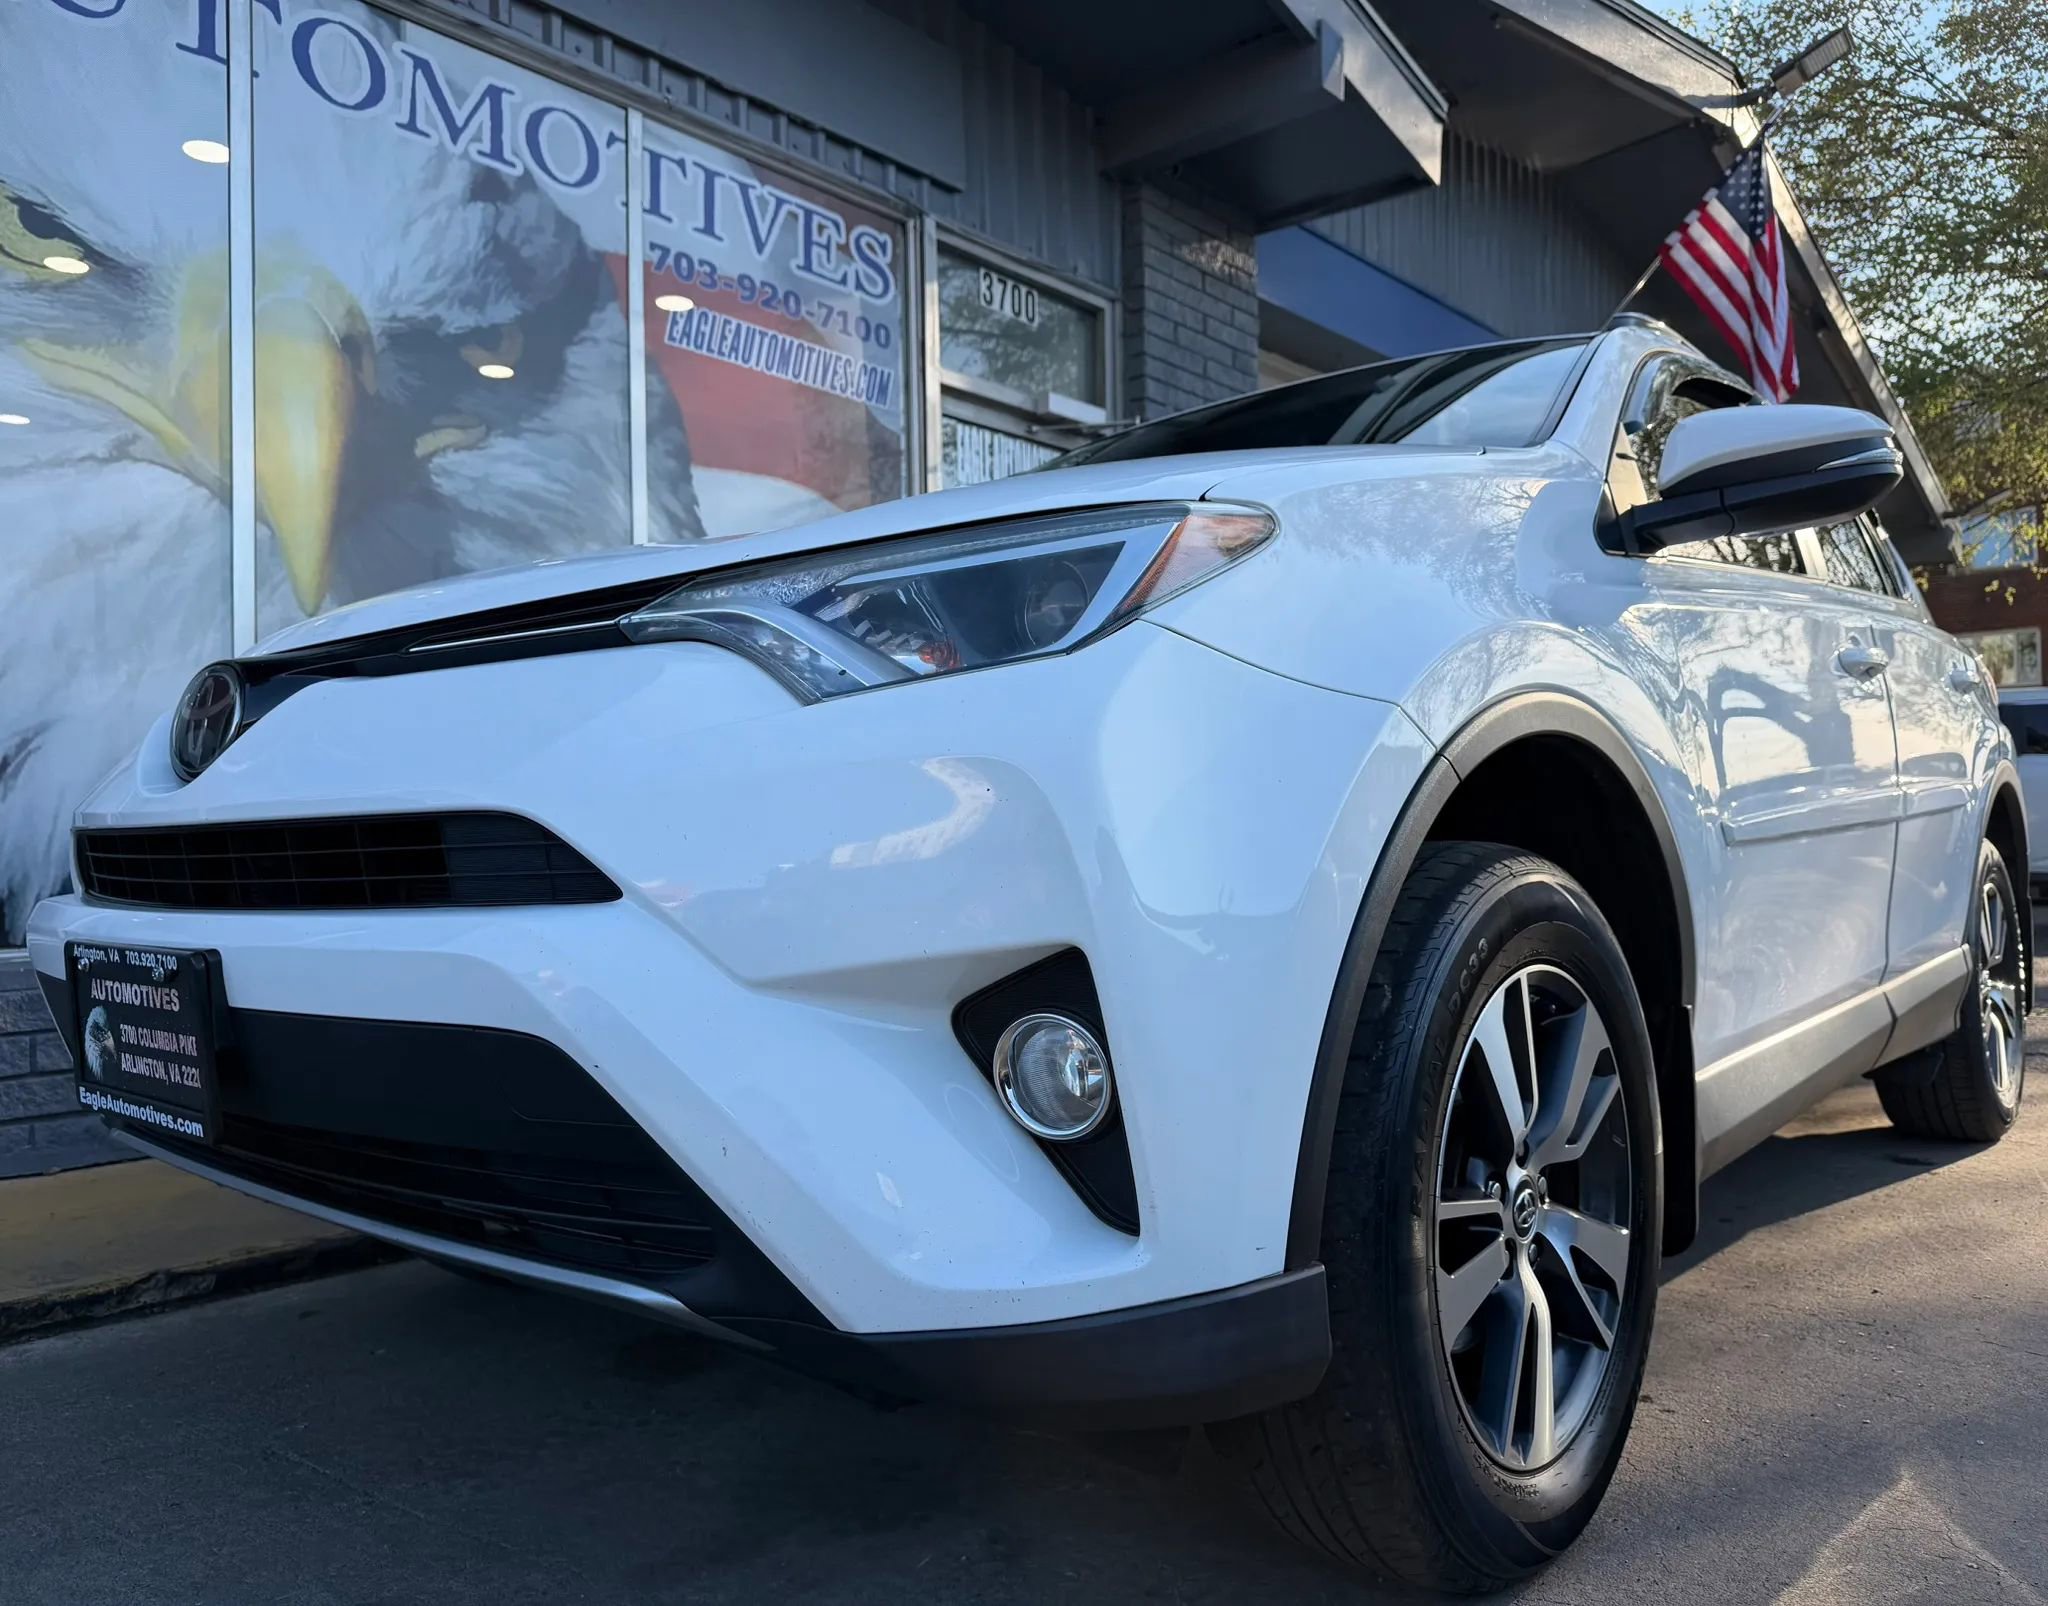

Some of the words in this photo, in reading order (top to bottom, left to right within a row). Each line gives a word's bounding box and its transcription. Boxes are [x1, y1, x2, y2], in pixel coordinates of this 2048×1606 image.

[649, 241, 892, 350] 703-920-7100
[983, 271, 1035, 323] 3700
[667, 308, 893, 407] EAGLEAUTOMOTIVES.COM
[108, 948, 120, 963] VA
[125, 950, 178, 971] 703.920.7100
[91, 978, 180, 1012] AUTOMOTIVES
[120, 1023, 138, 1045] 3700
[138, 1027, 179, 1054] COLUMBIA
[121, 1052, 169, 1085] ARLINGTON,
[168, 1061, 182, 1084] VA
[79, 1086, 204, 1138] EagleAutomotives.com
